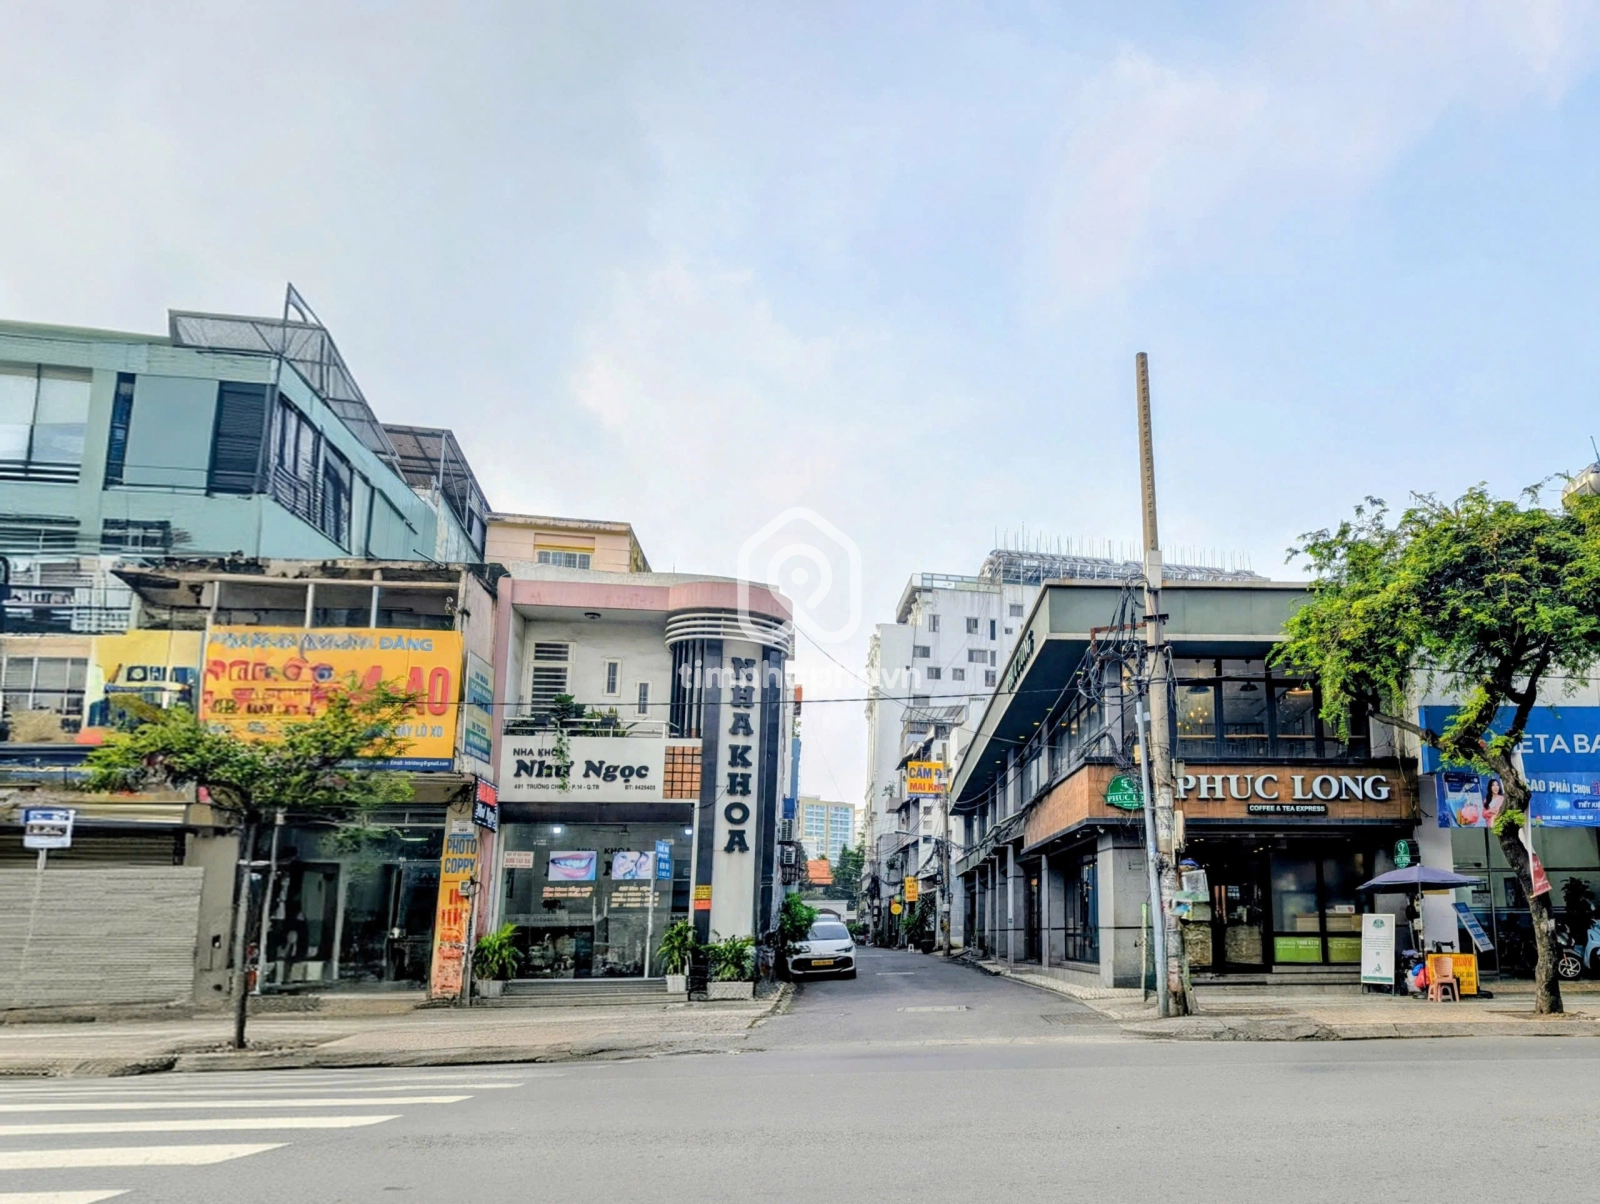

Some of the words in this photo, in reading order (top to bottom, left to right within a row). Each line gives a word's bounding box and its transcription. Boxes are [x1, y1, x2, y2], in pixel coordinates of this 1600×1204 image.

[513, 748, 534, 756] NHA
[513, 759, 575, 778] Như
[583, 760, 650, 783] Ngọc
[1175, 774, 1279, 800] PHUC
[1291, 774, 1391, 801] LONG
[1549, 779, 1571, 793] PHẢI
[1572, 783, 1591, 796] CHỌN
[446, 839, 477, 855] PHOTO
[444, 857, 476, 874] COPPY
